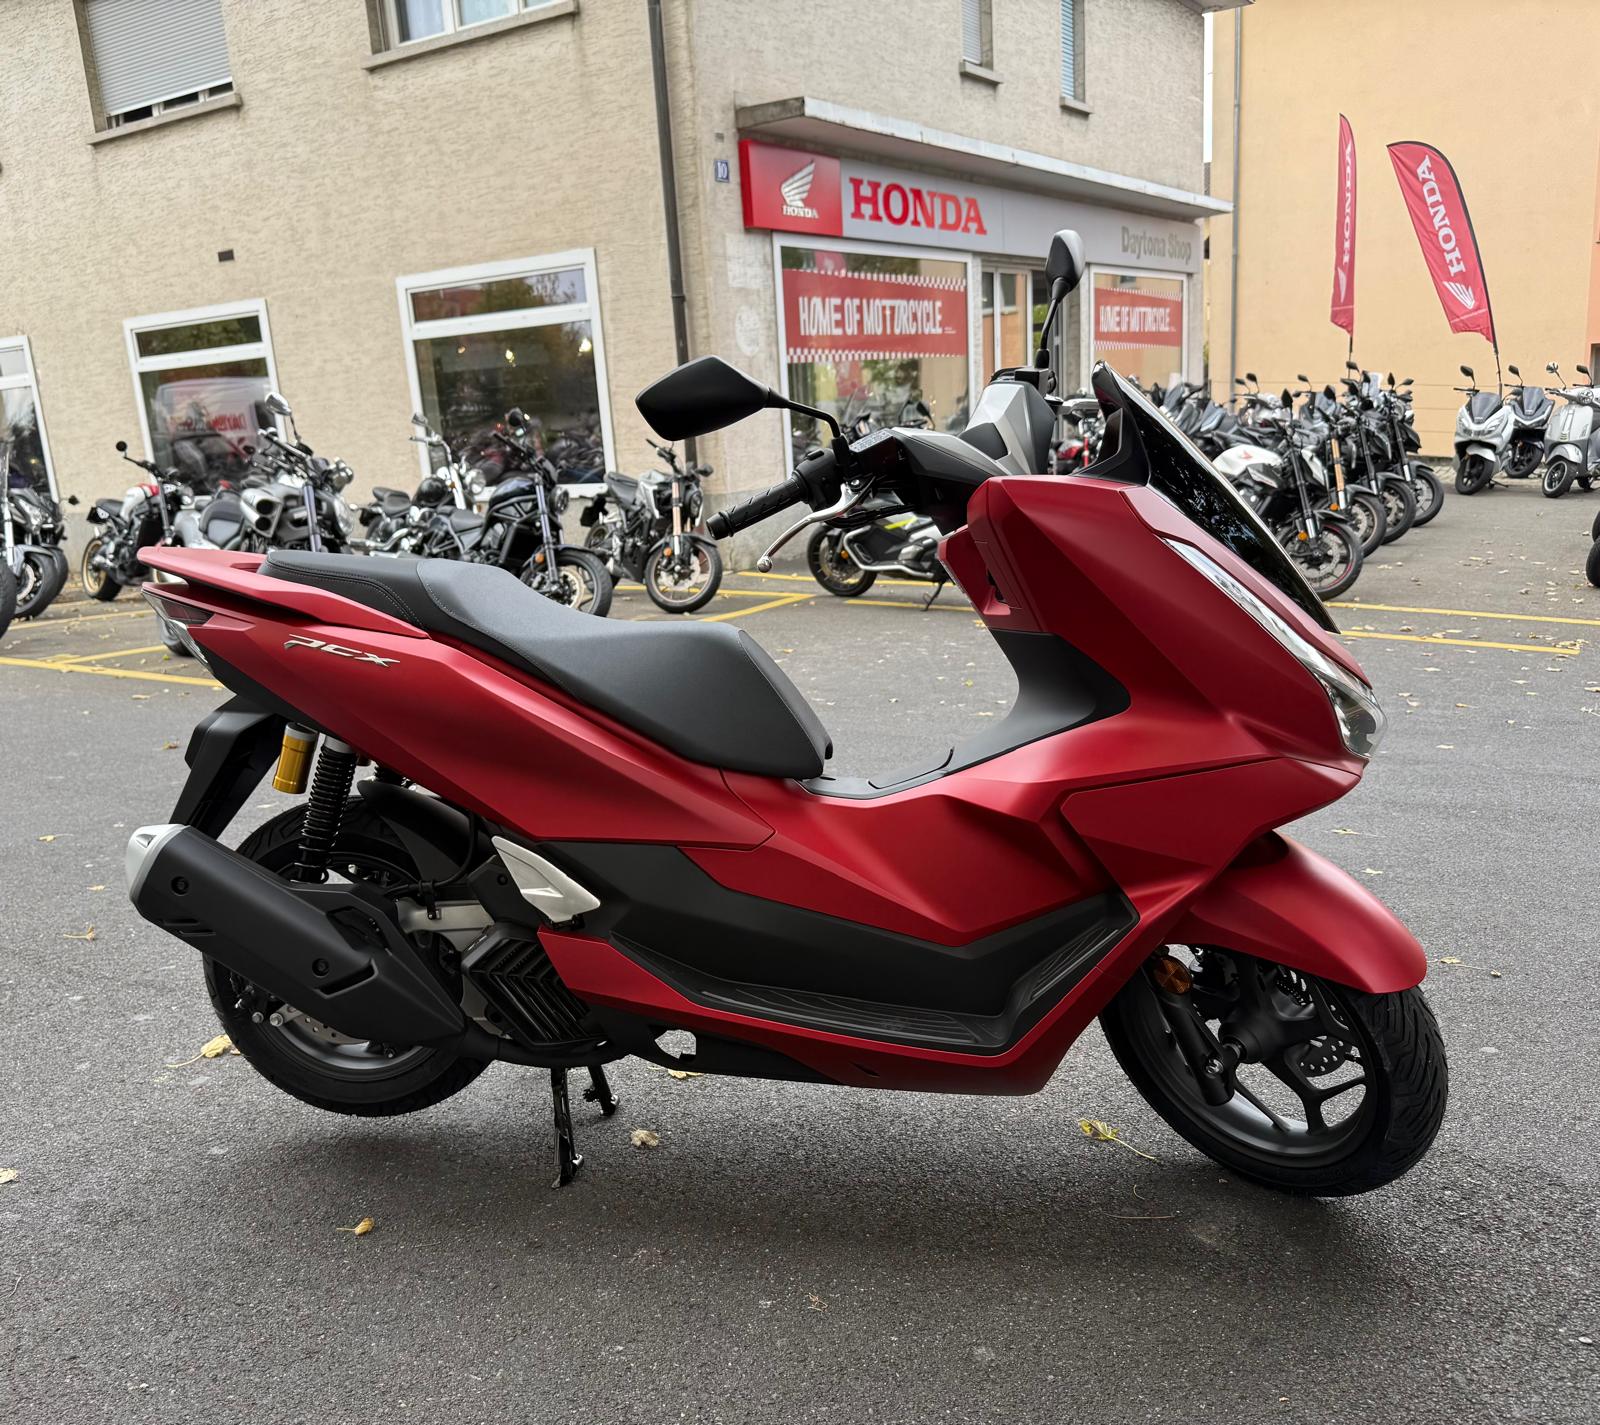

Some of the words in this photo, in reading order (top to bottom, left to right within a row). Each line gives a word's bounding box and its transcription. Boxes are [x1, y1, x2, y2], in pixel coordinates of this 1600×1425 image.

[782, 205, 819, 219] HONDA
[849, 177, 987, 235] HONDA
[1417, 155, 1466, 277] HONDA
[1121, 226, 1166, 259] Daytona
[1168, 233, 1192, 265] Shop
[799, 296, 843, 336] HOME
[844, 297, 861, 336] OF
[283, 633, 401, 668] PCX
